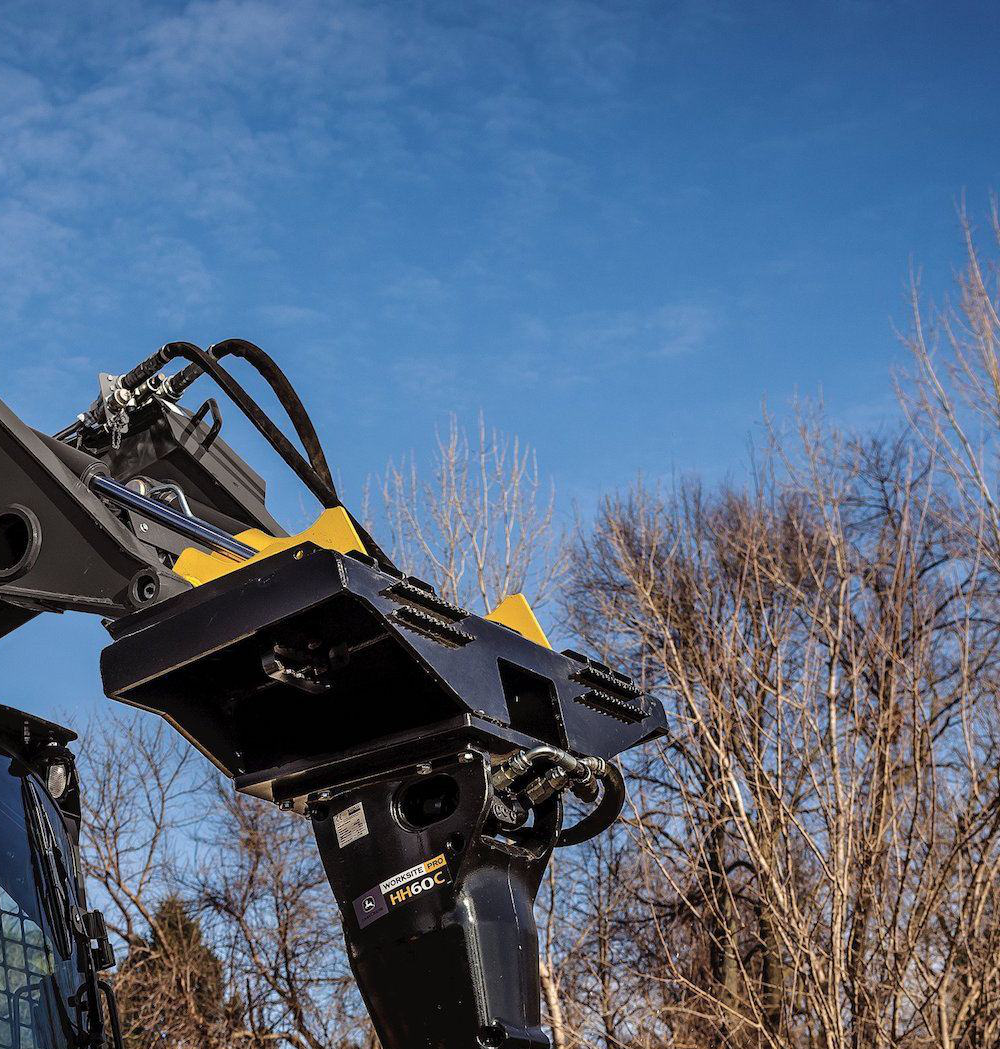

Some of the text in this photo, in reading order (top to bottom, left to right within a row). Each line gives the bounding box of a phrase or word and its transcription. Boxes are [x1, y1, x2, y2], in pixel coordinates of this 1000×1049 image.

[382, 857, 444, 890] WORKSITE PRO
[389, 871, 446, 906] HH60C
